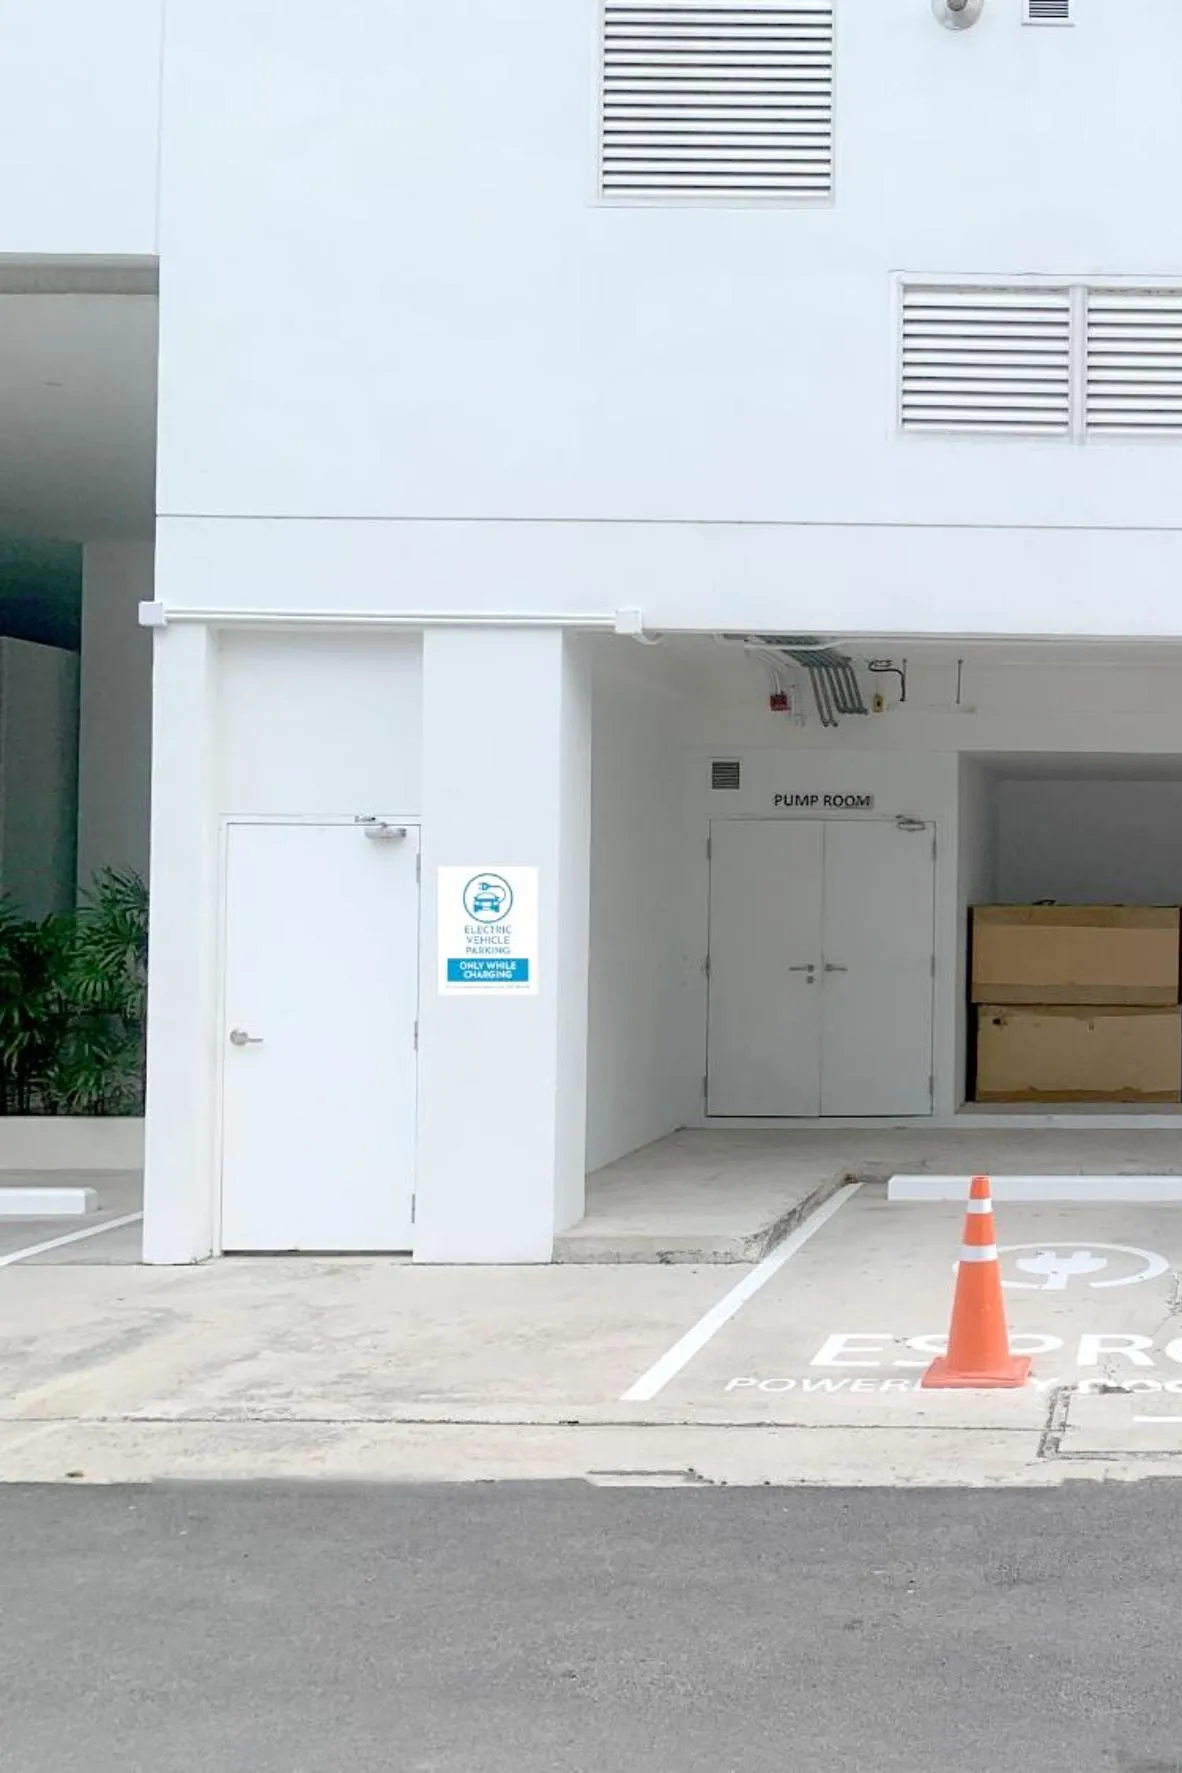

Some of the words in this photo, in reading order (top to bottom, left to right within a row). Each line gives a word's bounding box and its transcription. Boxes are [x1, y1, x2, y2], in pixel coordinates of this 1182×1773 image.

[773, 794, 819, 806] PUMP
[823, 794, 871, 807] ROOM
[464, 925, 512, 934] ELECTRIC
[466, 936, 511, 945] VEHICLE
[466, 946, 511, 955] PARKING
[459, 960, 484, 970] ONLY
[486, 960, 517, 970] WHILE
[464, 970, 513, 979] CHARGING
[724, 1377, 922, 1393] POWER
